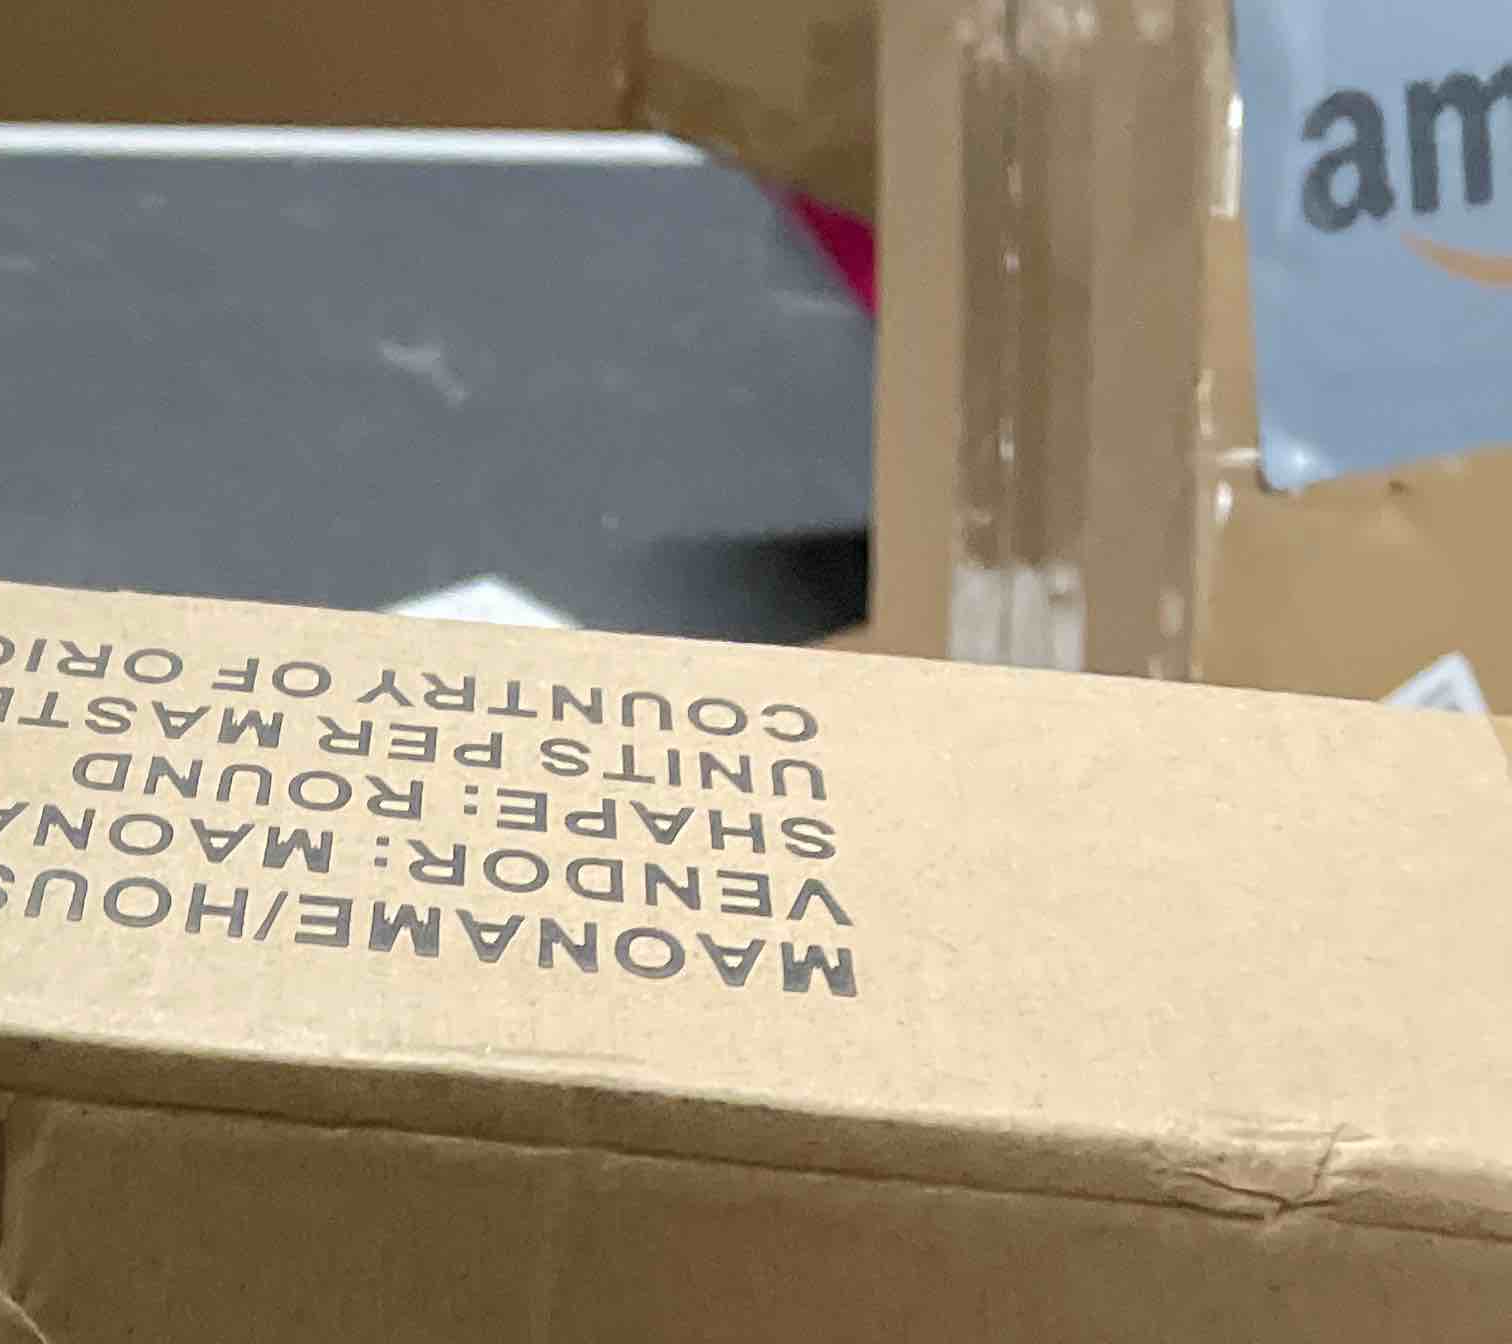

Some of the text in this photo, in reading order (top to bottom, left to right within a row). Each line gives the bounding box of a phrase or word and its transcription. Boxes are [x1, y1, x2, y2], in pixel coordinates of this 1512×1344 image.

[211, 657, 332, 699] OF
[357, 669, 819, 743] COUNTRY
[316, 715, 503, 770] PER
[539, 737, 827, 801] UNITS
[71, 752, 837, 860] SHAPE: ROUND
[373, 835, 854, 927] VENDOR:
